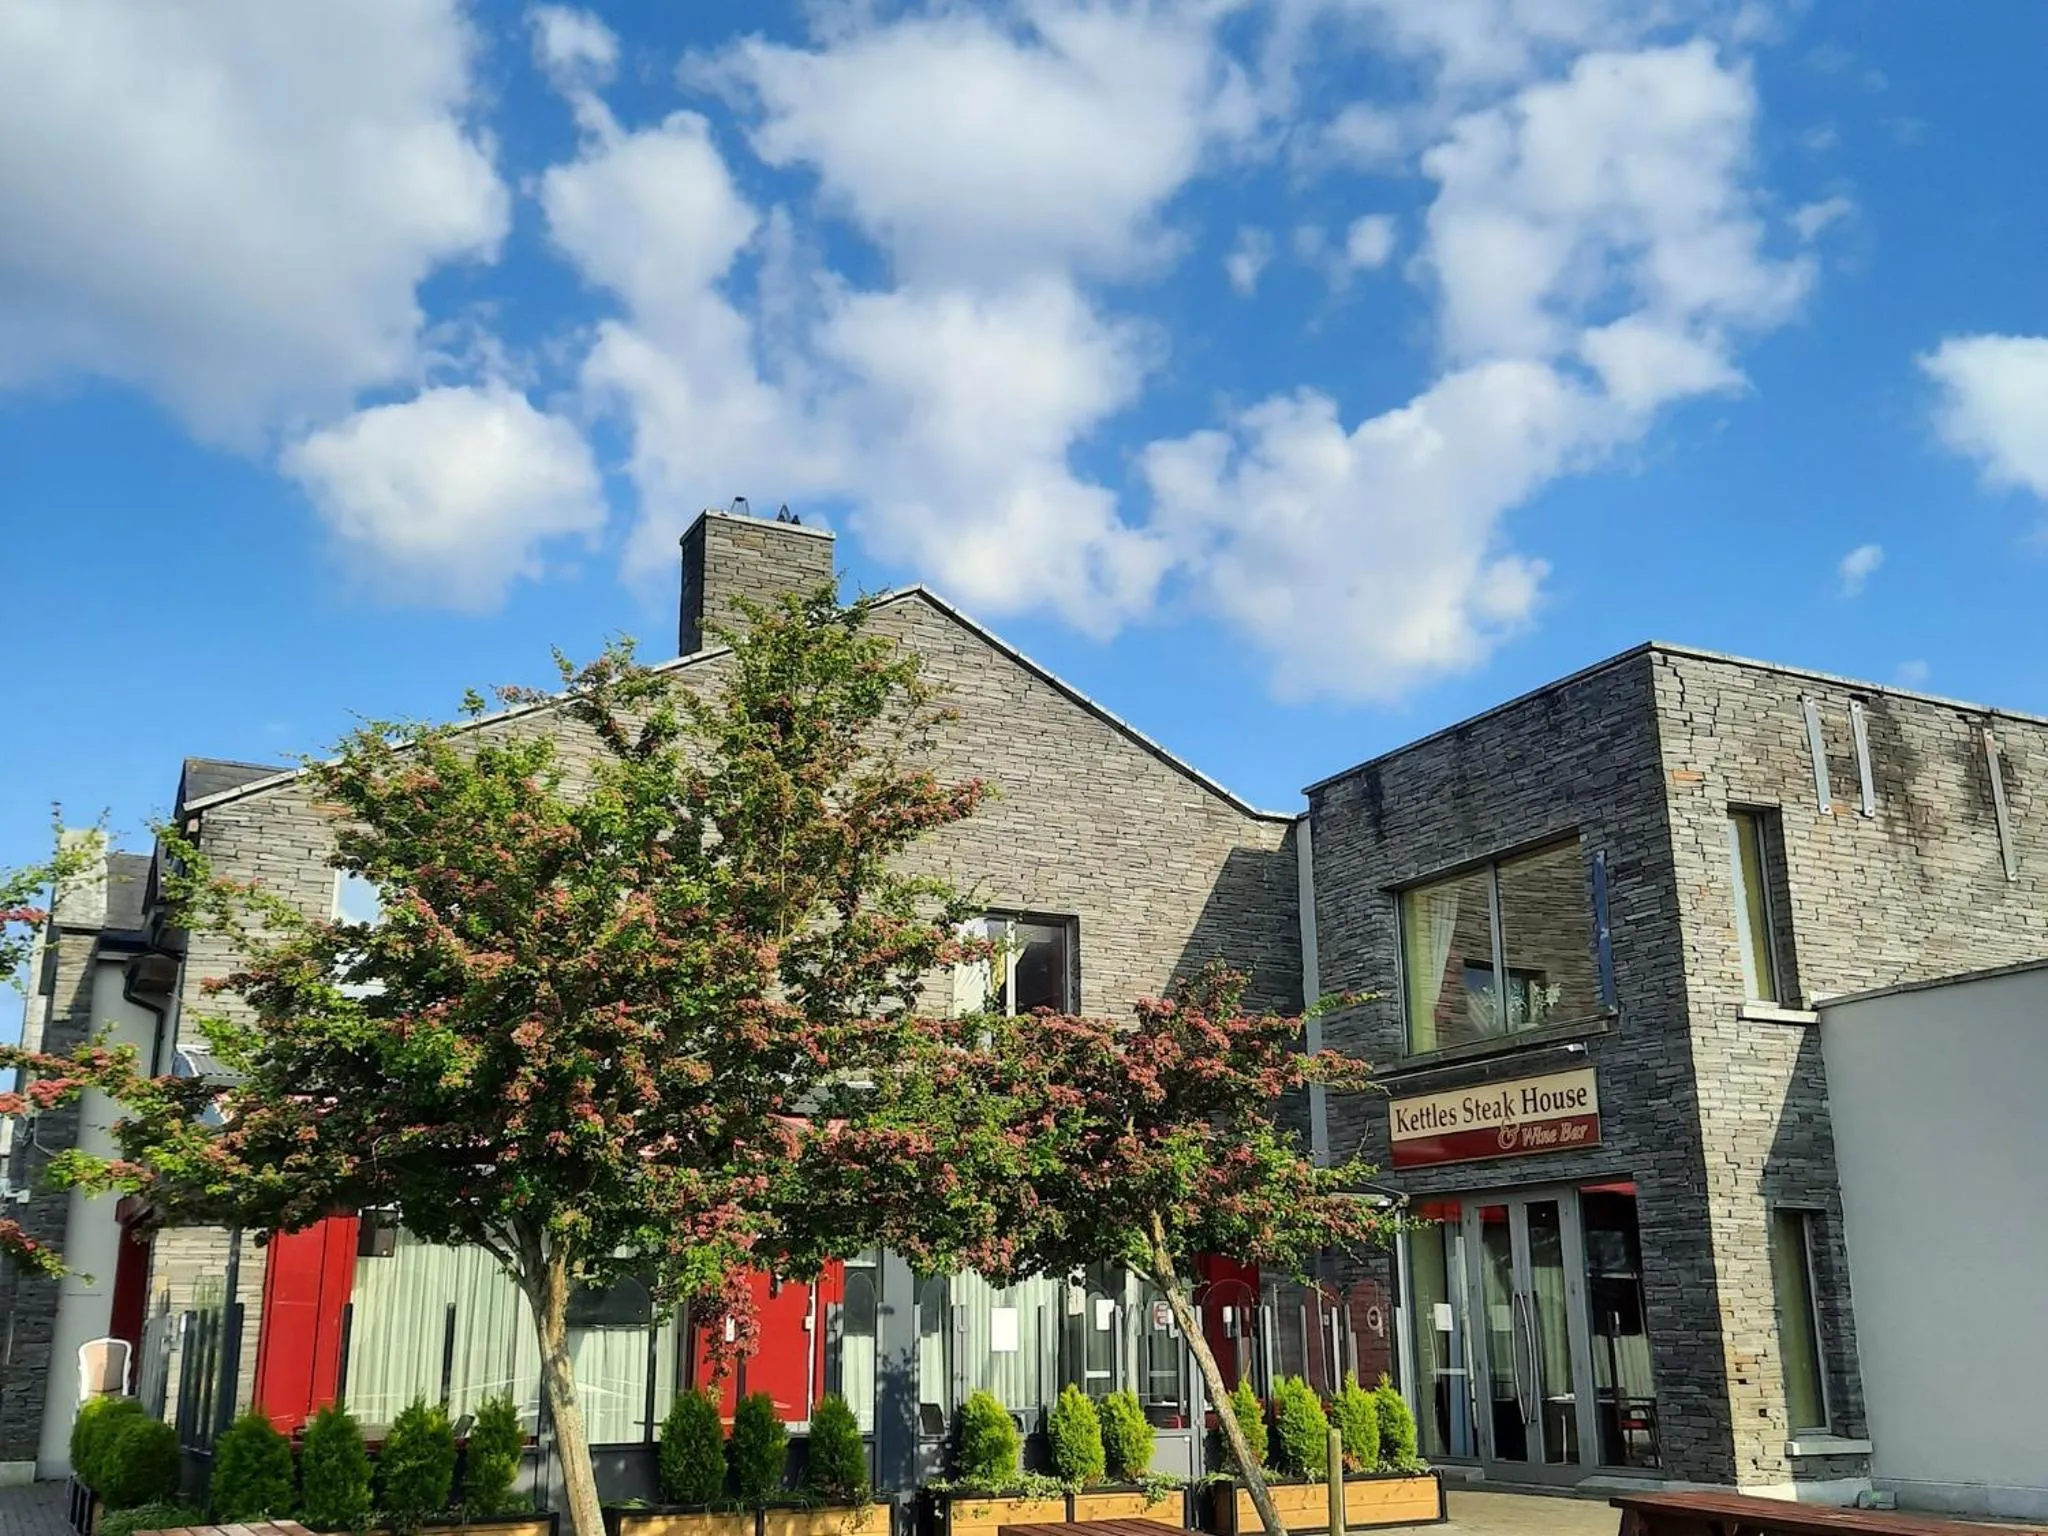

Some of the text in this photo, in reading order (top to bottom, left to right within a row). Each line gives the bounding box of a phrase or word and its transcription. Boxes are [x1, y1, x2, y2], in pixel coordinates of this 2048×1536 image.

[1395, 1086, 1588, 1133] Kettles Steak House
[1498, 1117, 1589, 1149] & Wine Bar
